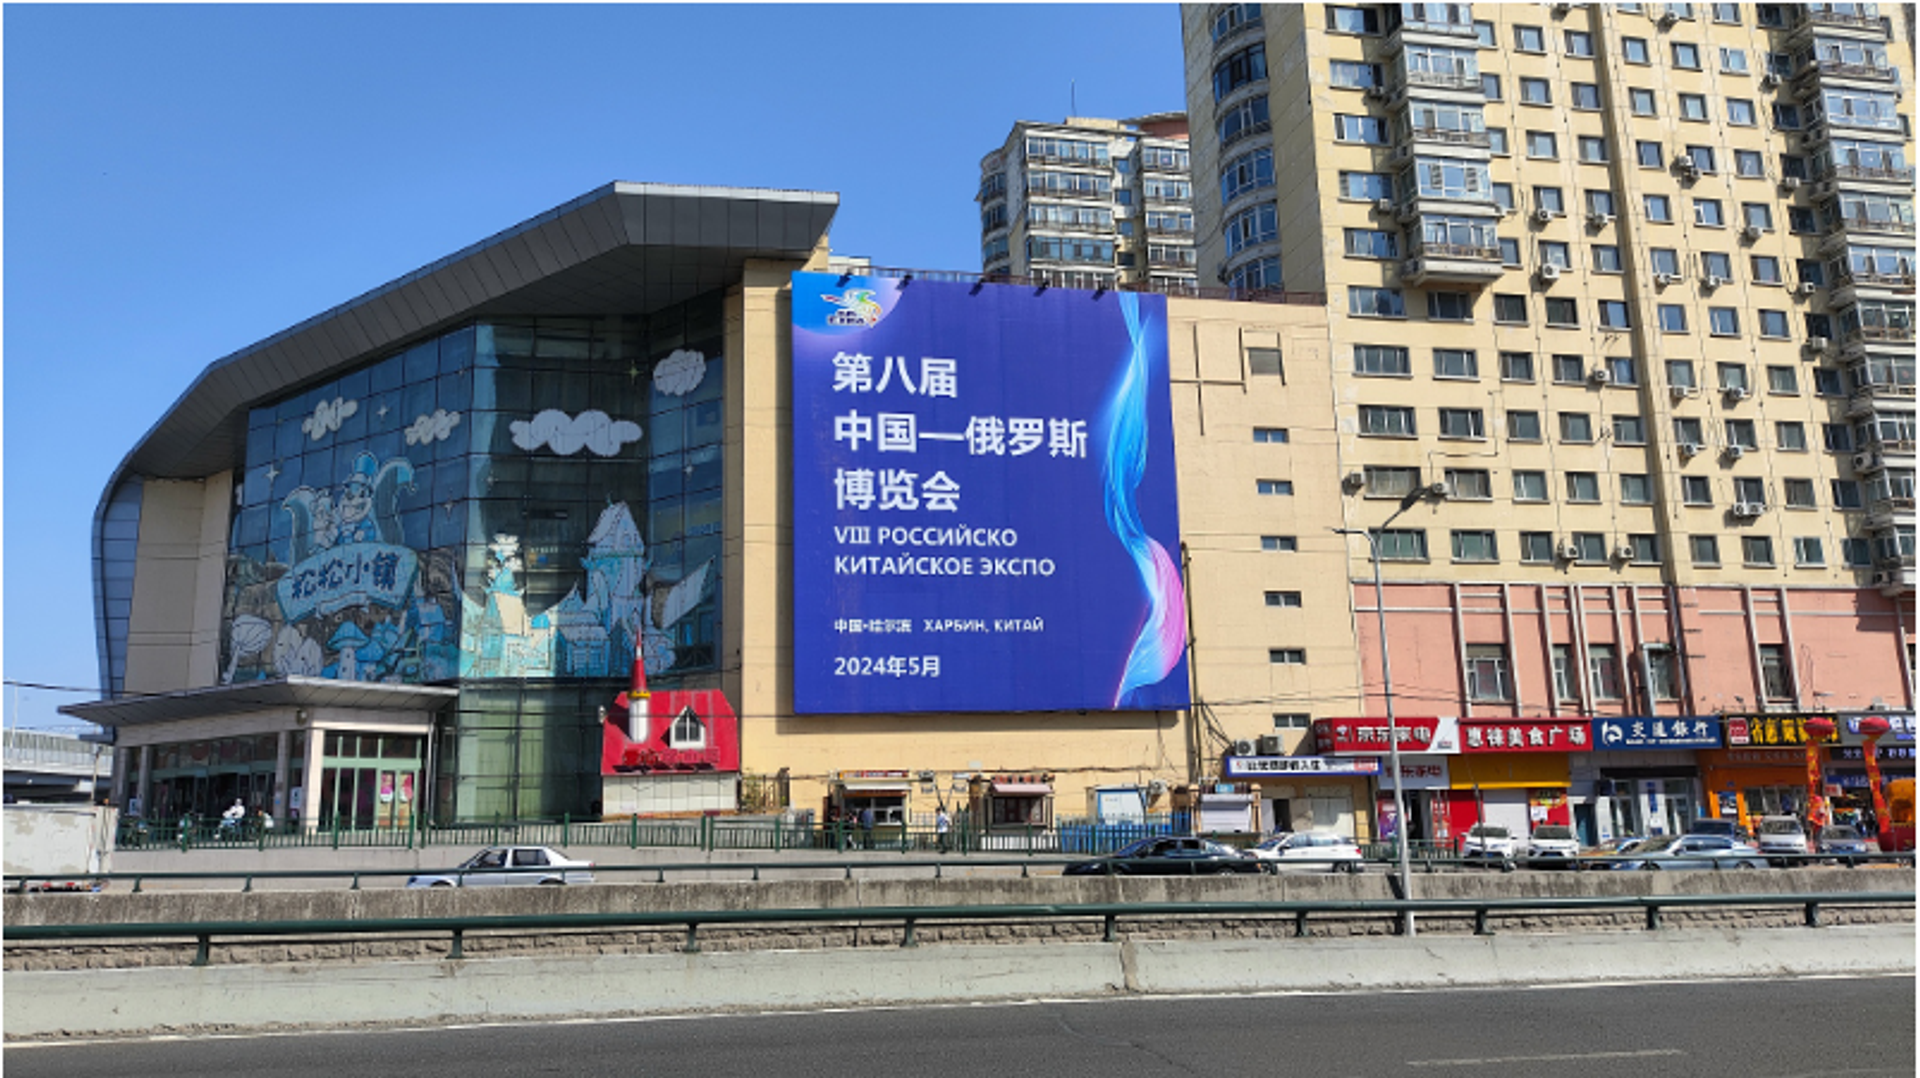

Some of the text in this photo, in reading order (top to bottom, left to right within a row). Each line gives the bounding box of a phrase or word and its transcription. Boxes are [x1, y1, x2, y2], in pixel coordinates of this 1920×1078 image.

[832, 352, 958, 399] 第八届
[834, 467, 961, 512] 博览会
[877, 524, 1018, 547] РОССИЙСКО
[292, 551, 399, 599] 松松小镇
[834, 552, 1056, 577] КИТАЙСКОЕ ЭКСПО
[923, 618, 990, 633] ХАРБИН,
[994, 616, 1044, 633] КИТАЙ
[834, 655, 941, 678] 2024年5月
[1356, 724, 1431, 743] 京东家电
